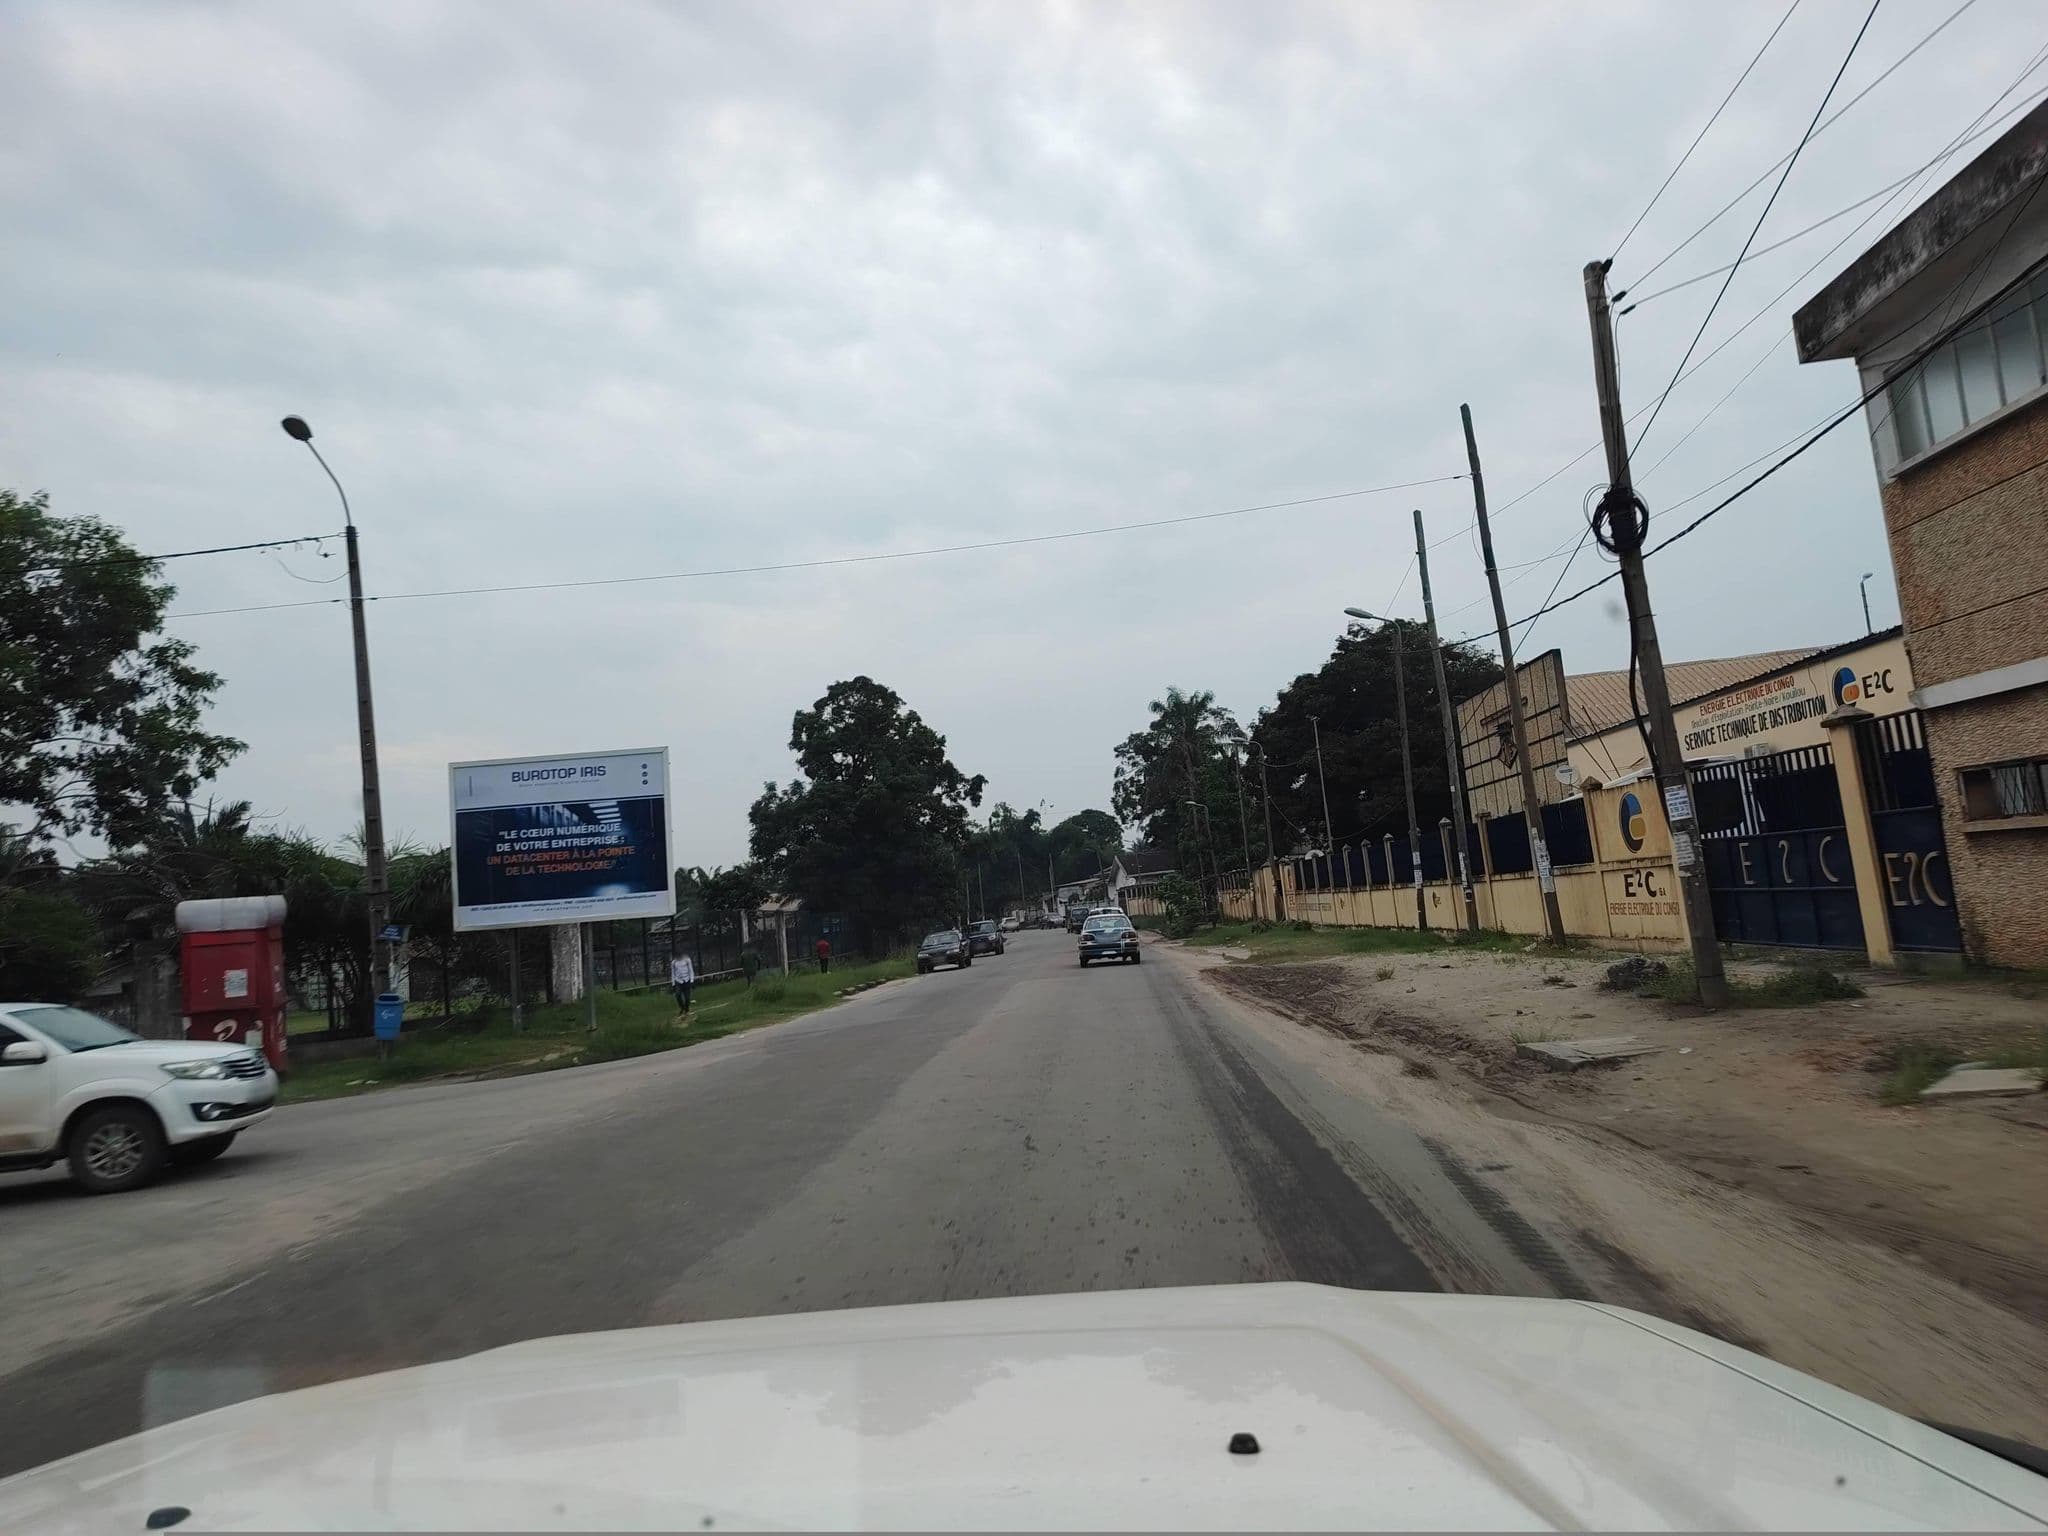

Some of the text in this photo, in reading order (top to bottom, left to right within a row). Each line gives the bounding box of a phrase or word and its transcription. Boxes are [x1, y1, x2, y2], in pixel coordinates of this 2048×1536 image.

[1699, 675, 1795, 716] ENERGIE ELECTRIQUE DU CONGO
[1684, 694, 1827, 751] SERVICE TECHNIQUE DE DISTRIBUTION
[512, 765, 606, 782] BUROTOP IRIS
[520, 826, 554, 839] CŒUR
[556, 822, 621, 836] NUMÉRIQUE
[496, 842, 511, 852] DE
[513, 840, 550, 851] VOTRE
[552, 836, 618, 849] ENTREPRISE
[487, 855, 501, 865] UN
[503, 851, 569, 864] DATACENTER
[582, 848, 596, 858] LA
[598, 845, 636, 857] POINTE
[506, 866, 520, 876] DE
[521, 865, 536, 875] LA
